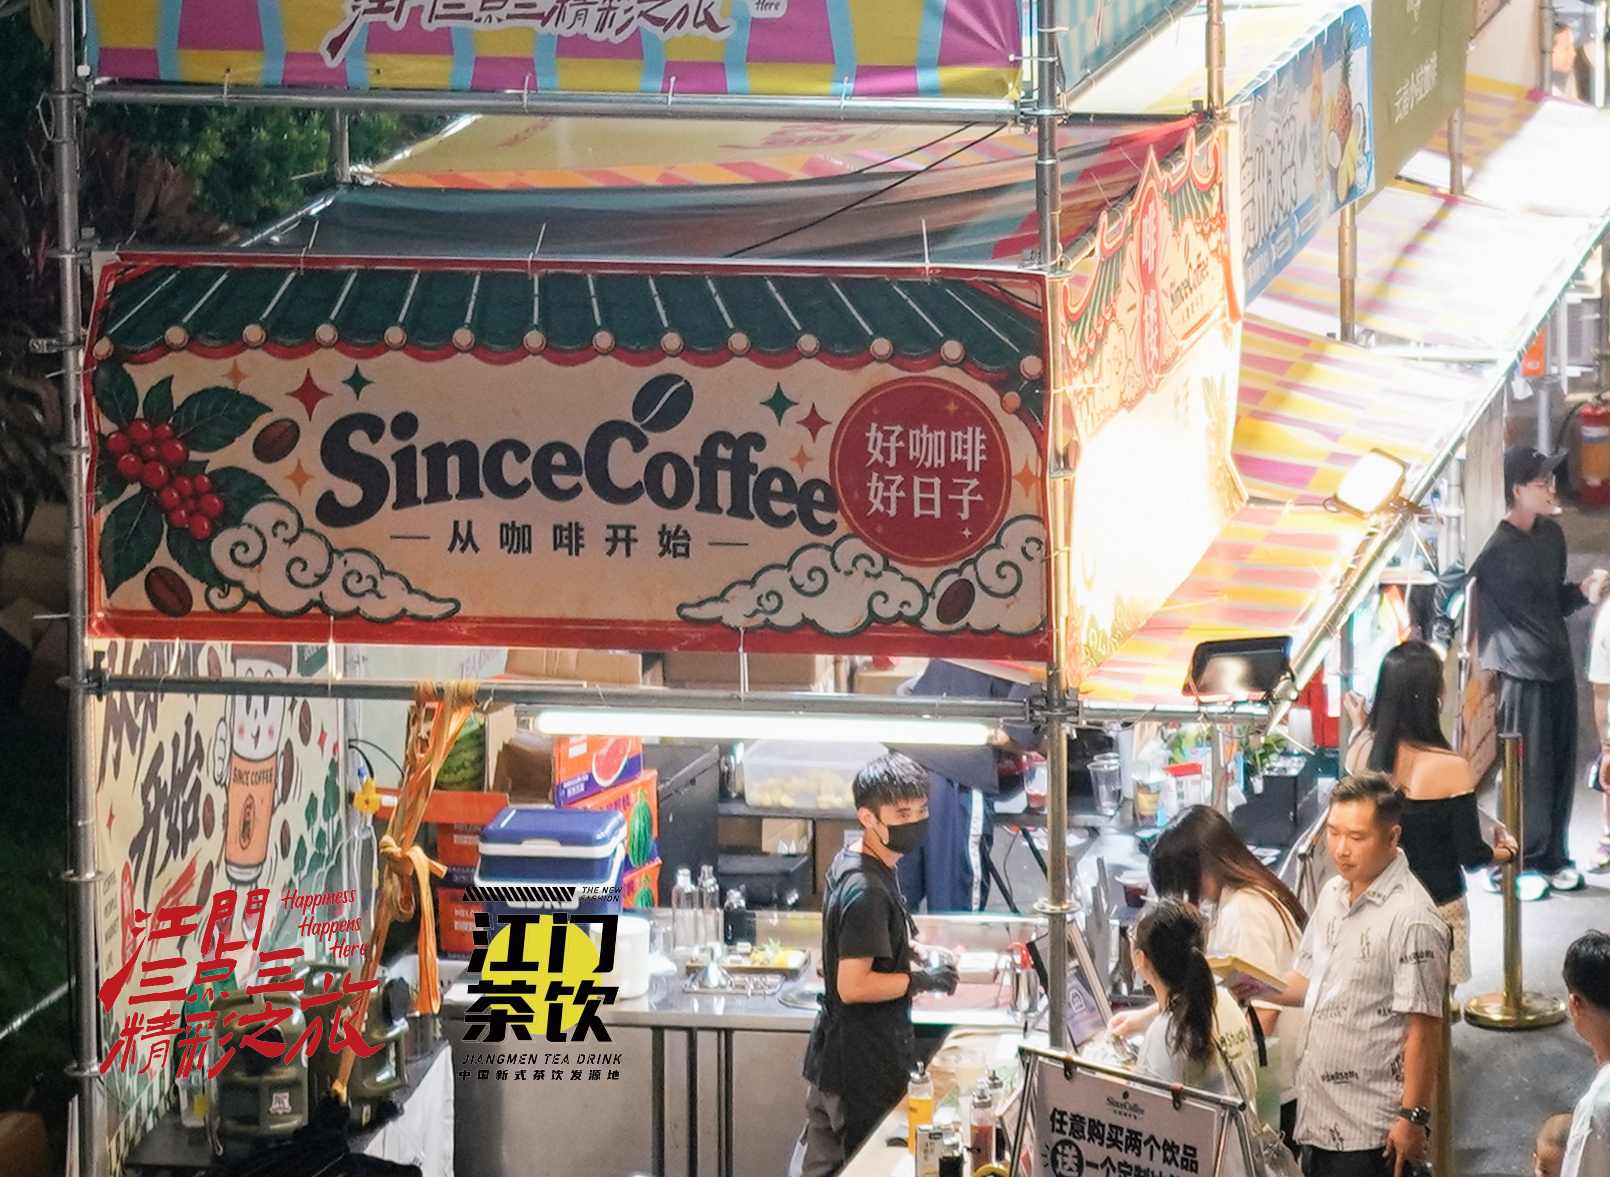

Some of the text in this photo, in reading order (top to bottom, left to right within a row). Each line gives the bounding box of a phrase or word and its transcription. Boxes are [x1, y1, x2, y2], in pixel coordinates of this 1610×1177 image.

[865, 421, 988, 468] 好咖啡
[316, 410, 839, 537] SinceCoffee
[866, 470, 984, 520] 好日子
[447, 520, 692, 560] 从咖啡开始
[1050, 1108, 1199, 1174] 任意购买两个饮品
